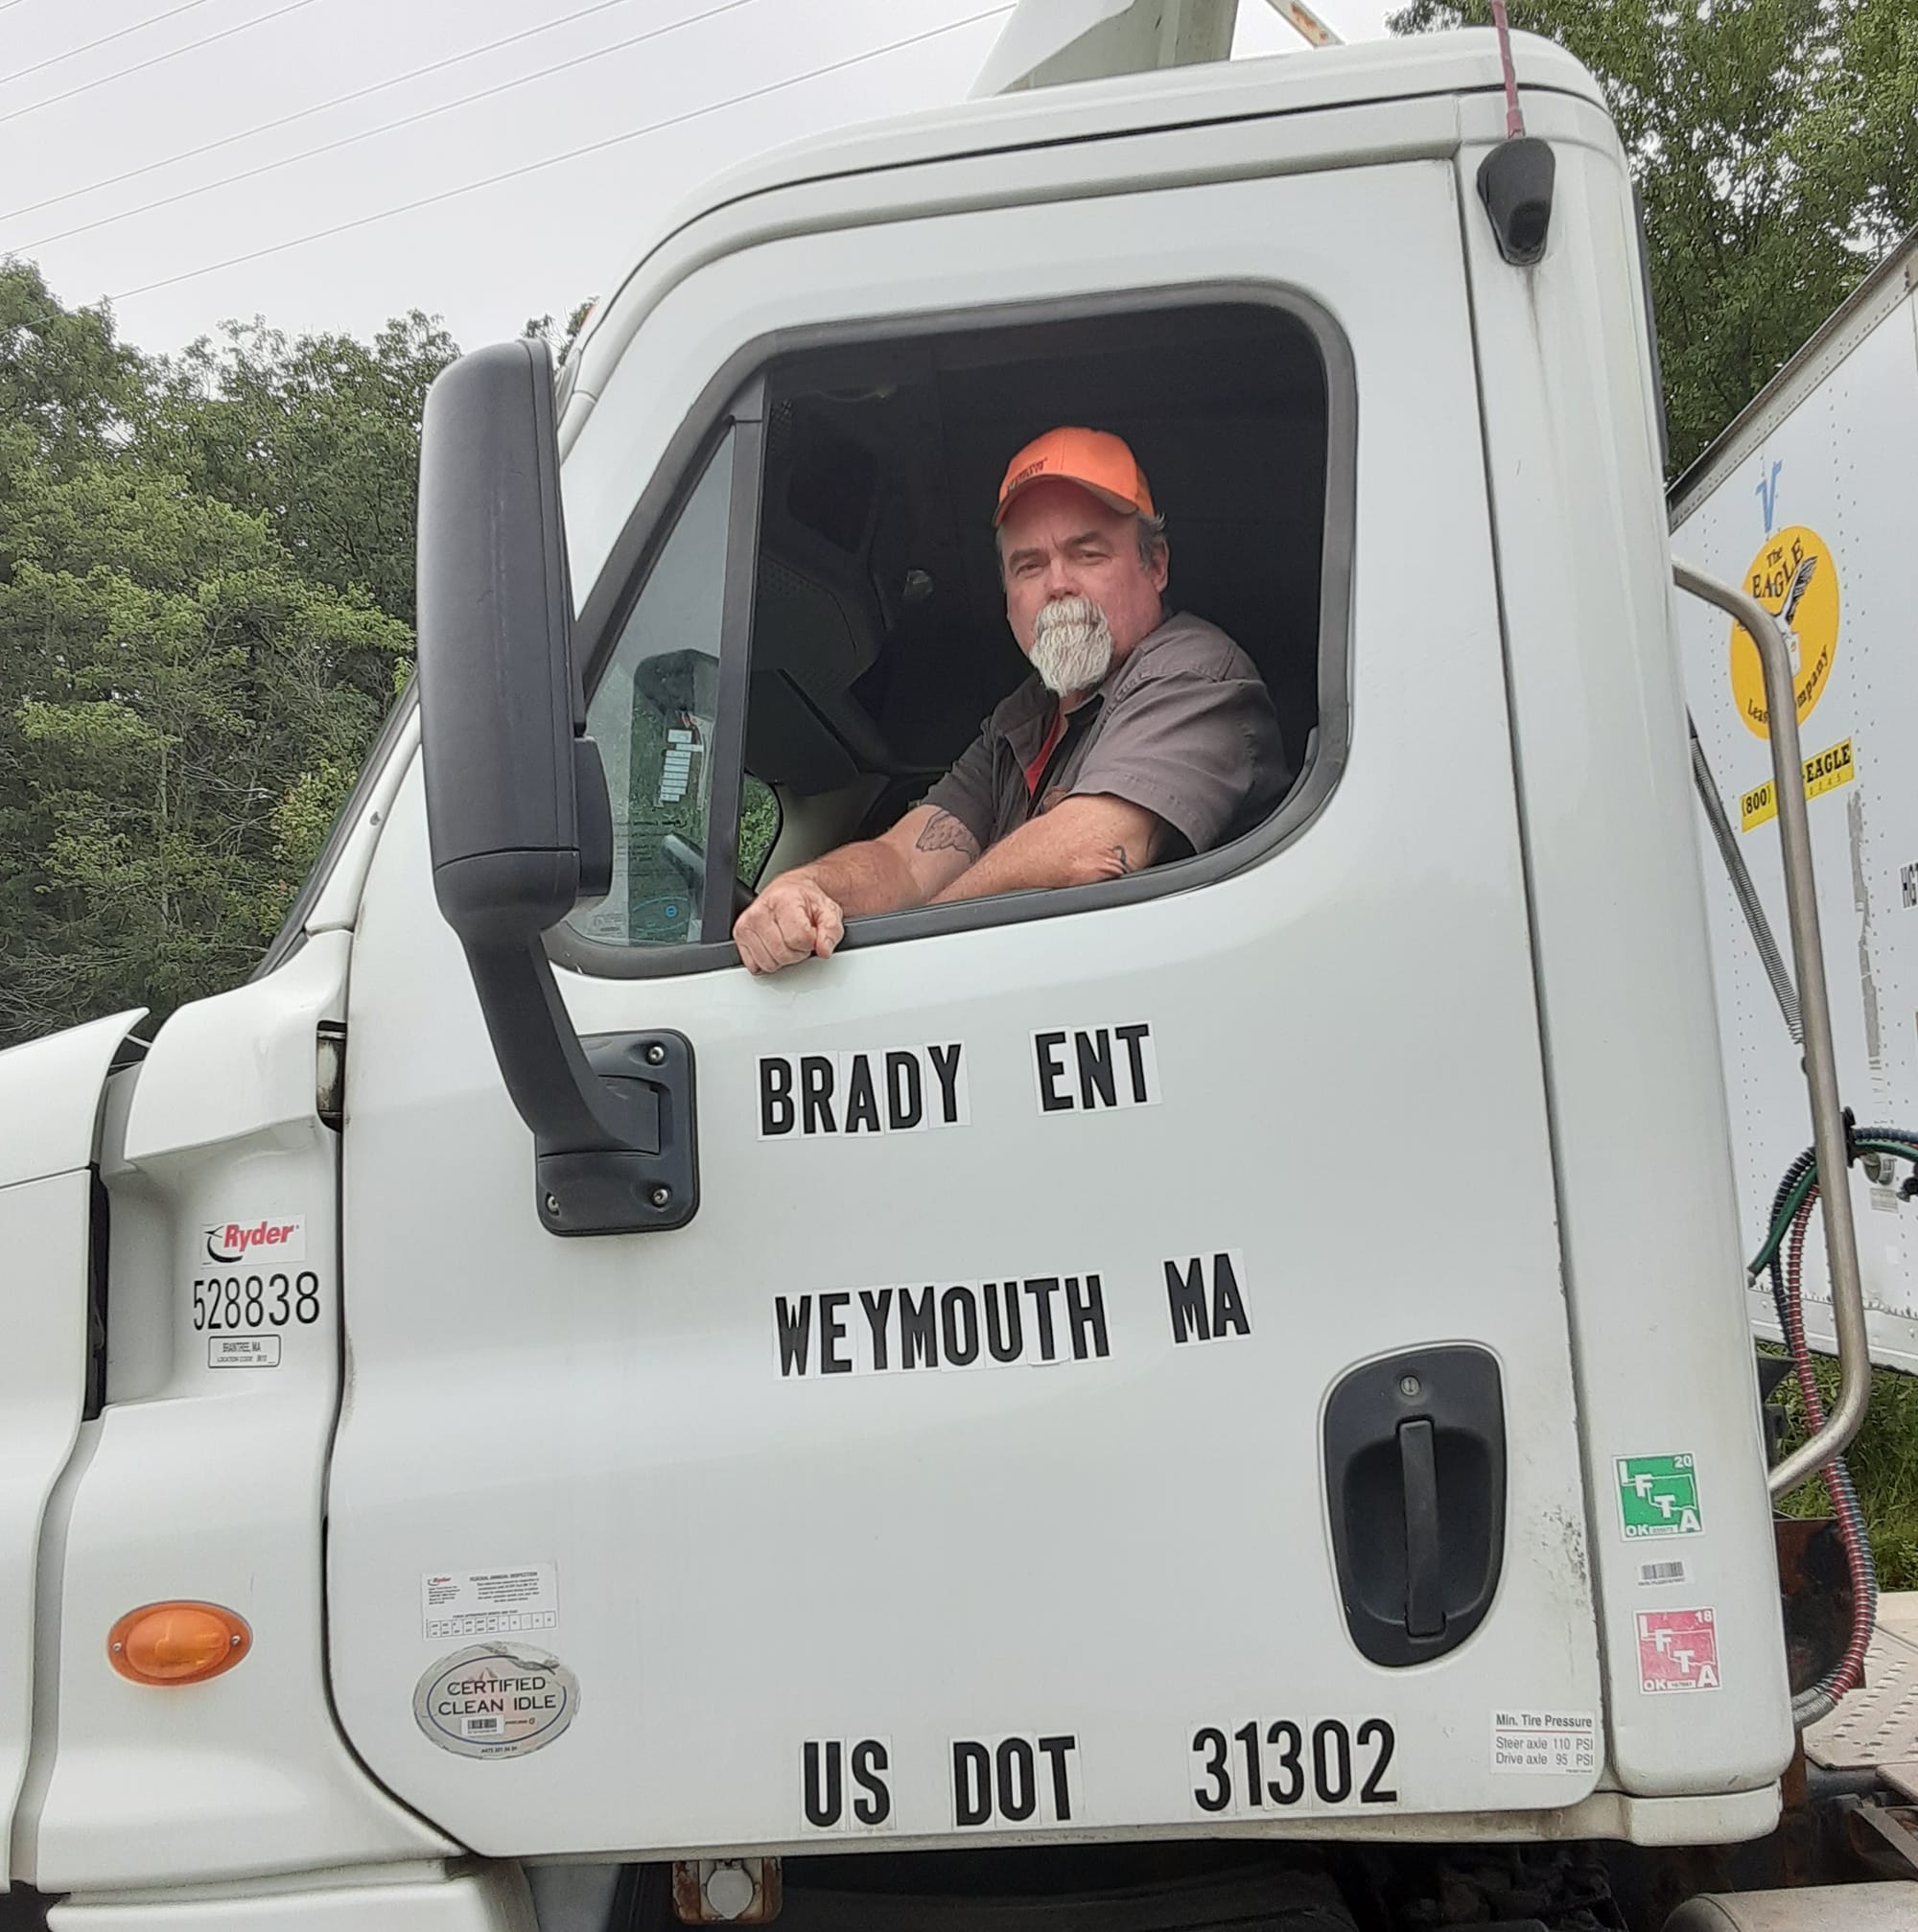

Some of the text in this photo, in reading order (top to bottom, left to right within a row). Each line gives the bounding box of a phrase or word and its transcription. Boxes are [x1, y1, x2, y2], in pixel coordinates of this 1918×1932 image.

[1752, 535, 1804, 599] EAGLE
[1766, 546, 1783, 568] The
[1747, 643, 1828, 724] Leas mpany
[1742, 785, 1771, 817] (800)
[1900, 863, 1918, 909] HG
[760, 1023, 1150, 1135] BRADY ENT
[223, 1221, 294, 1252] Ryder
[193, 1270, 320, 1331] 528838
[775, 1252, 1251, 1377] WEYMOUTH MA
[1673, 1455, 1693, 1468] 20
[1626, 1524, 1649, 1536] OK
[1695, 1610, 1713, 1624] 18
[447, 1676, 547, 1696] CERTIFIED
[1644, 1678, 1668, 1691] OK
[437, 1694, 557, 1716] CLEAN IDLE
[1496, 1713, 1592, 1728] Min. Tire Pressure
[1496, 1736, 1593, 1751] Steer axle 110 PSI
[1496, 1752, 1593, 1766] Drive axle 95 PSI
[803, 1718, 1398, 1827] US DOT 31302
